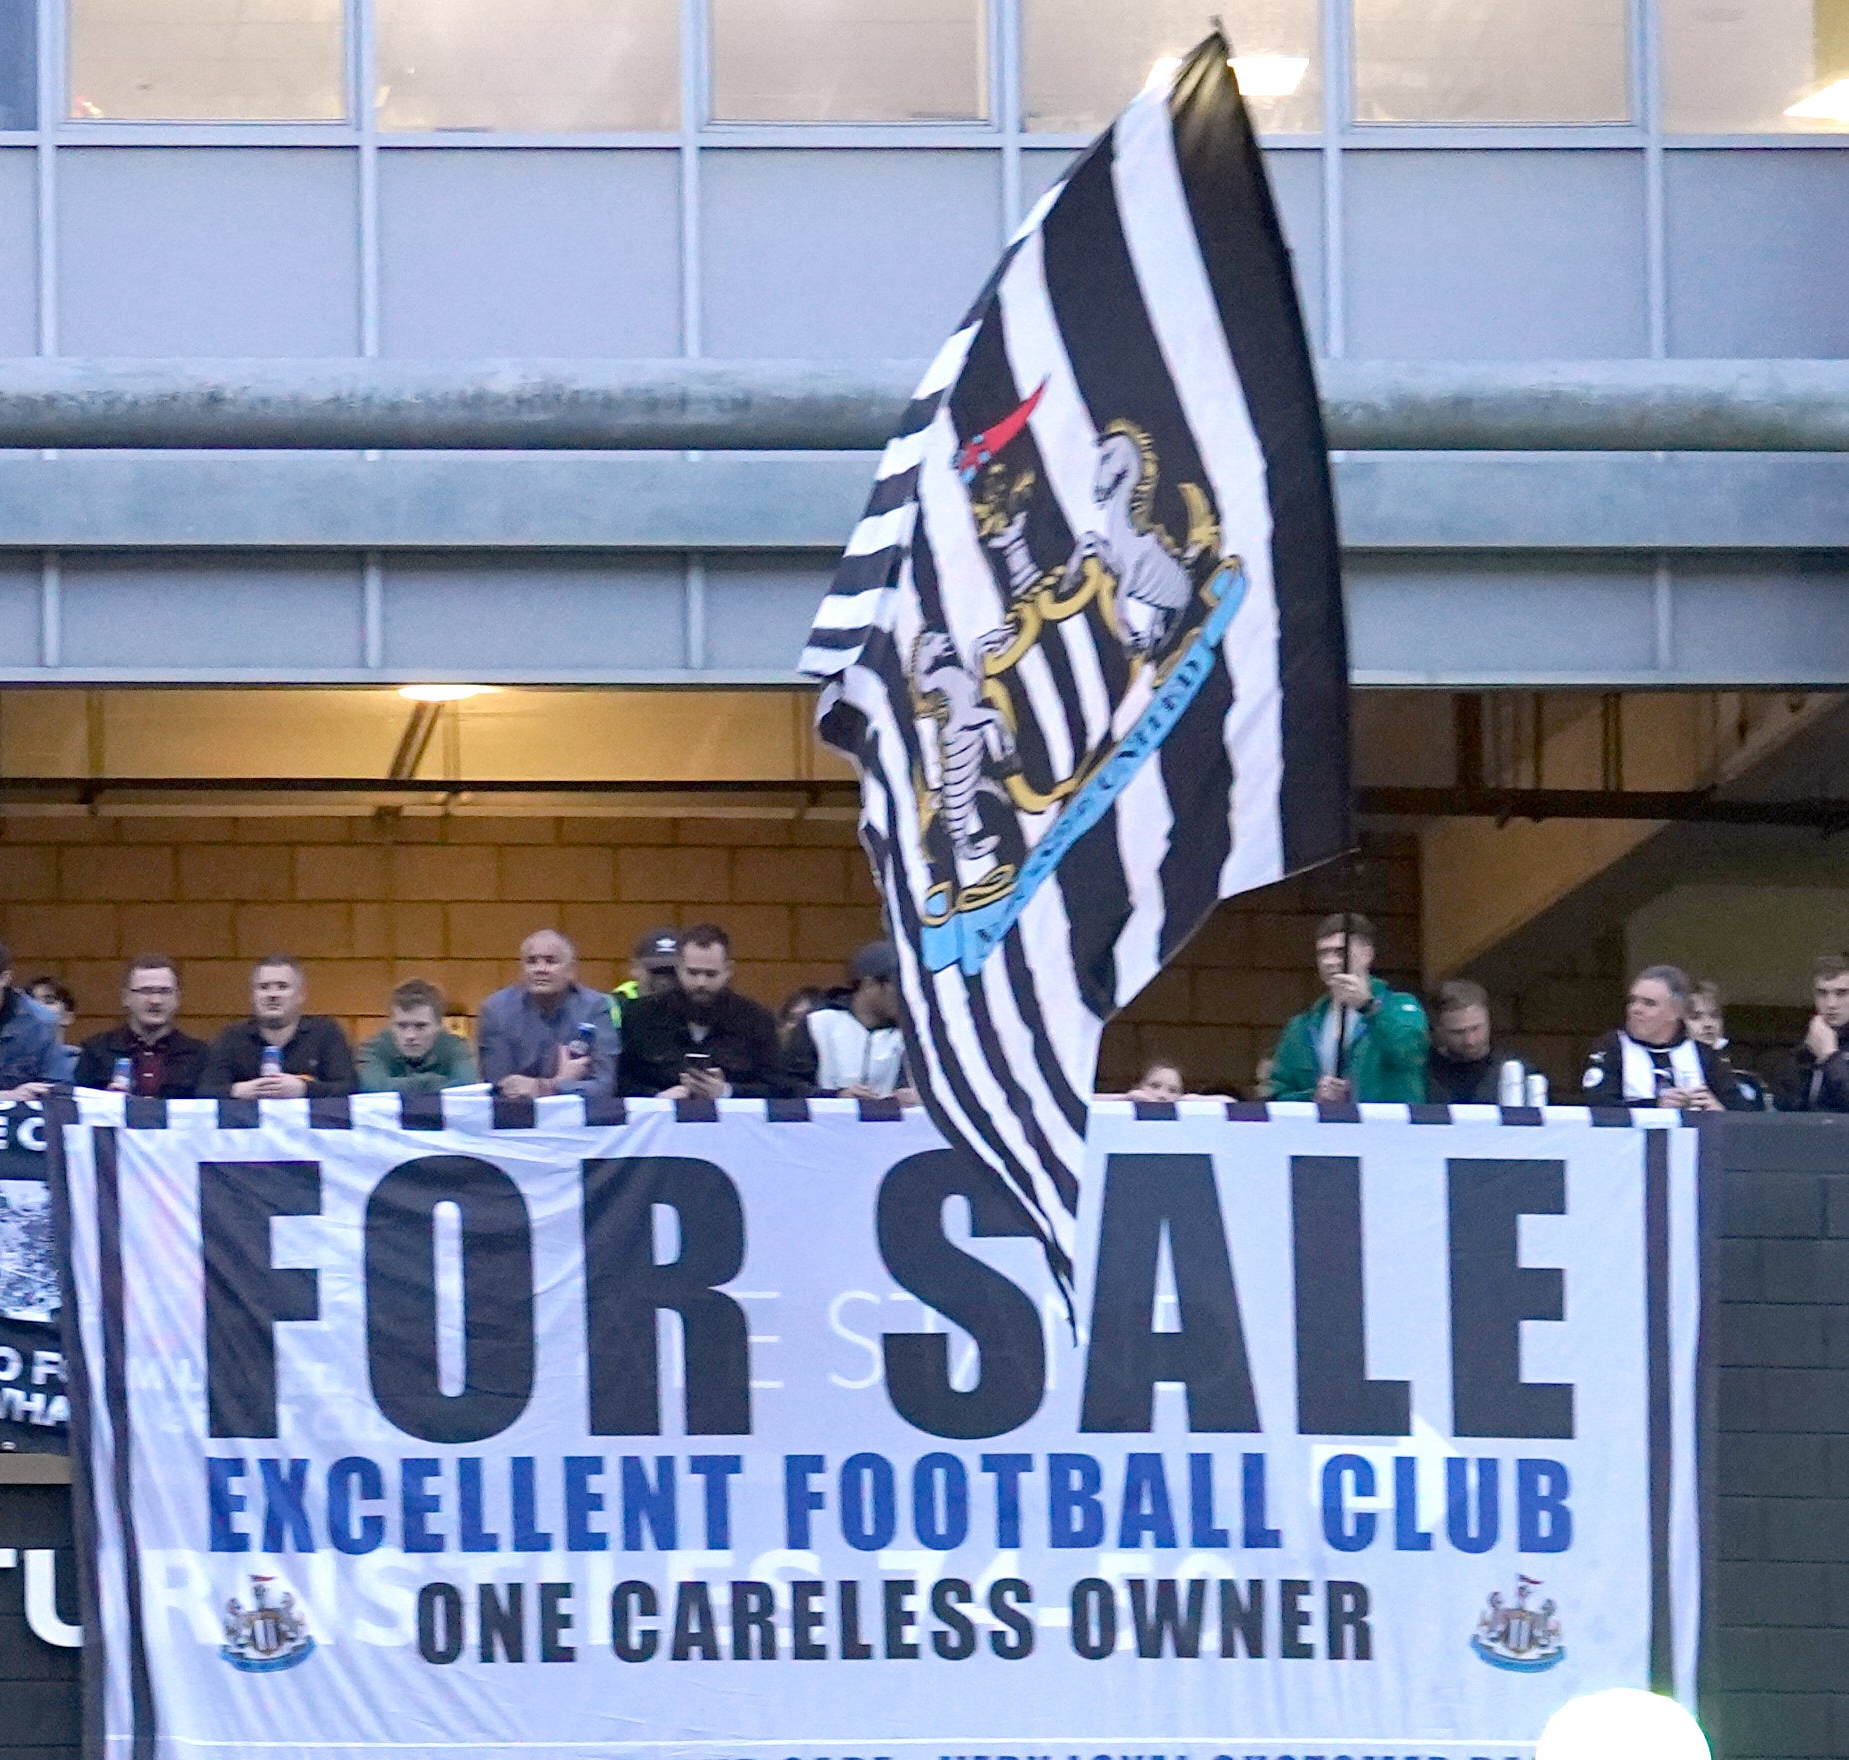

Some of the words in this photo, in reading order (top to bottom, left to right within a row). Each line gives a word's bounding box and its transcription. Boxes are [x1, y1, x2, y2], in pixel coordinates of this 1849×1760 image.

[199, 1154, 753, 1445] FOR
[876, 1147, 1576, 1441] SALE
[207, 1454, 743, 1554] EXCELLENT
[785, 1452, 1282, 1552] FOOTBALL
[1321, 1453, 1575, 1554] CLUB
[417, 1580, 576, 1666] ONE
[611, 1576, 1035, 1665] CARELESS
[1070, 1576, 1373, 1662] OWNER
